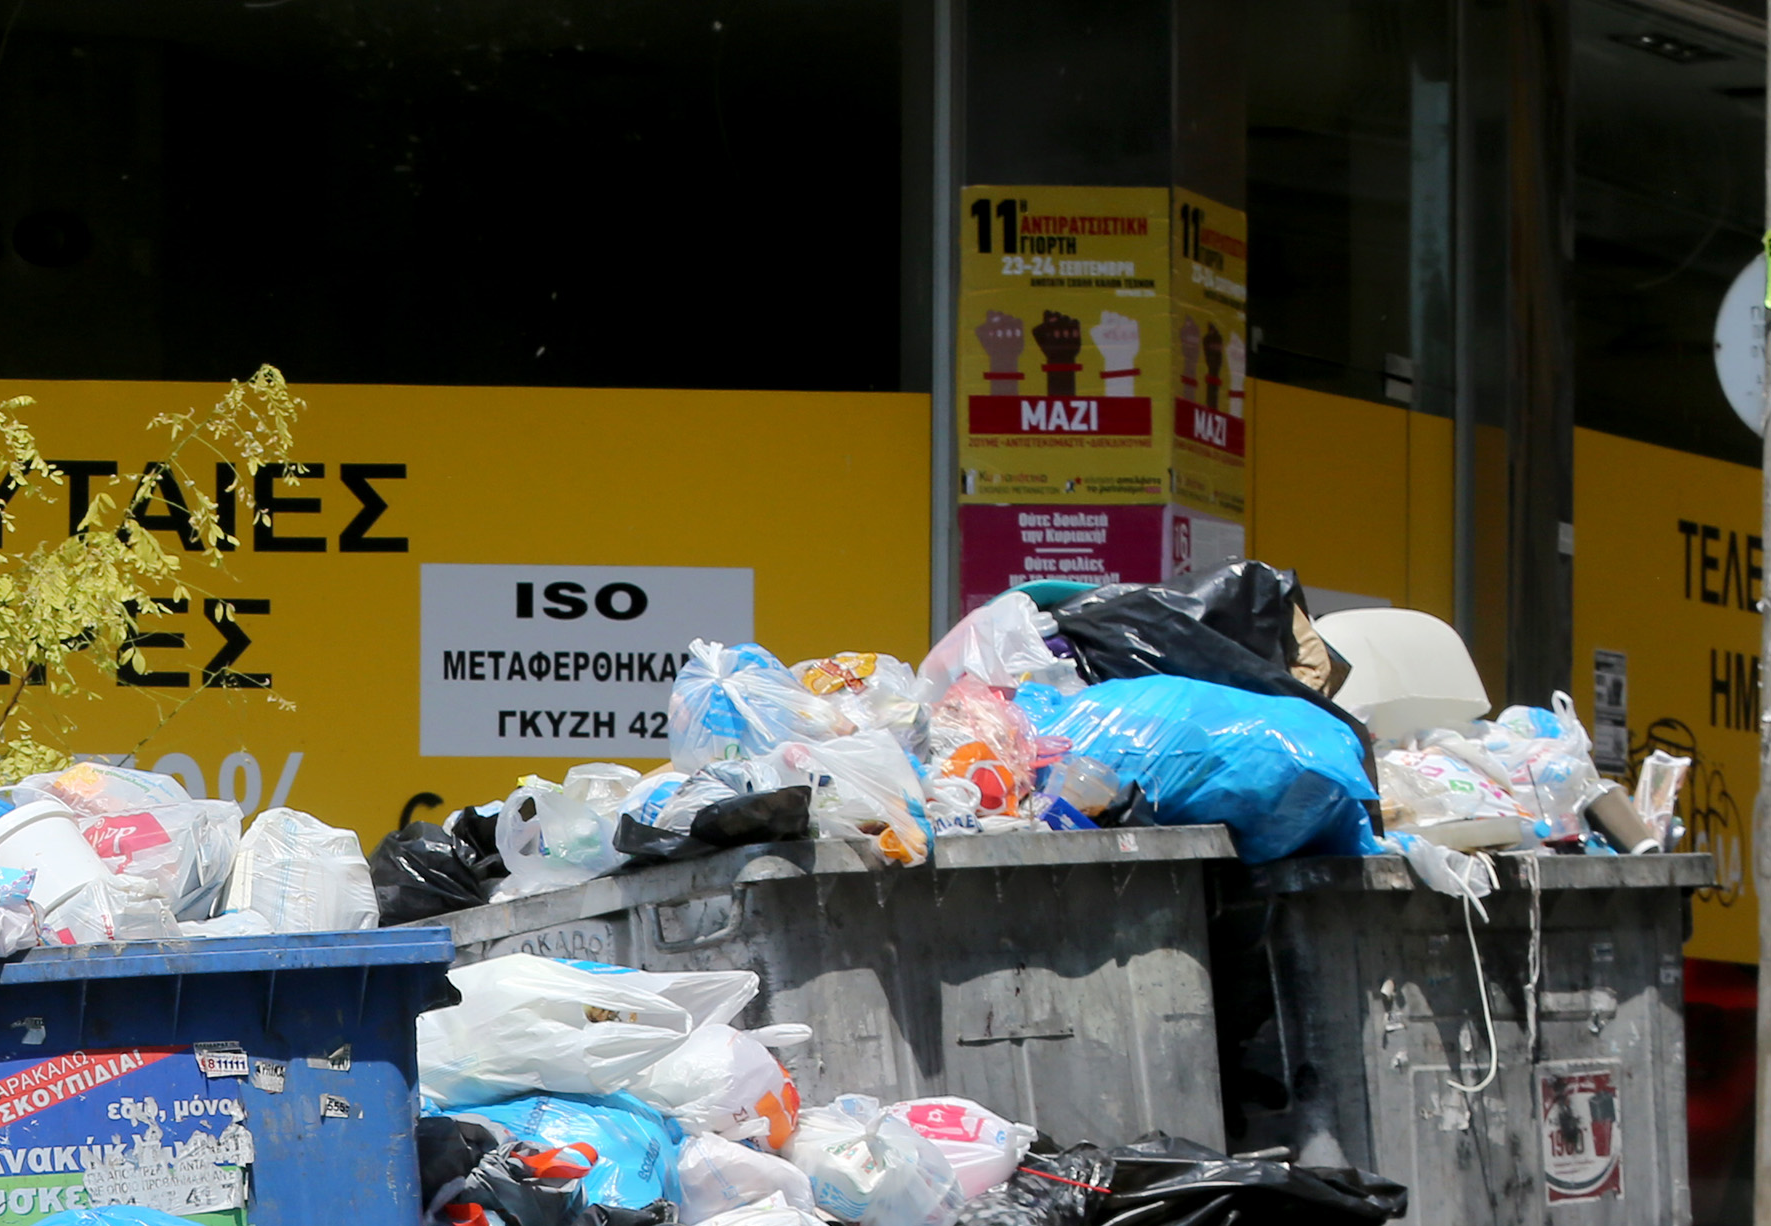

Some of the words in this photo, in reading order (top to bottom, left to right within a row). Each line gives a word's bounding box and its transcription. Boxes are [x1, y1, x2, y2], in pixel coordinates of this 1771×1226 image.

[971, 199, 1017, 253] 11
[1020, 216, 1148, 235] ΑΝΤΙΡΑΤΣΙΣΤΙΚΗ
[1020, 236, 1077, 254] ΓΙΟΡΤΗ
[1001, 256, 1056, 275] 23-24
[1021, 400, 1099, 431] ΜΑΖΙ
[1194, 408, 1227, 447] ΜΑΖΙ
[516, 581, 649, 620] ISO
[498, 710, 616, 738] ΓΚΥΖΗ
[629, 711, 669, 738] 42
